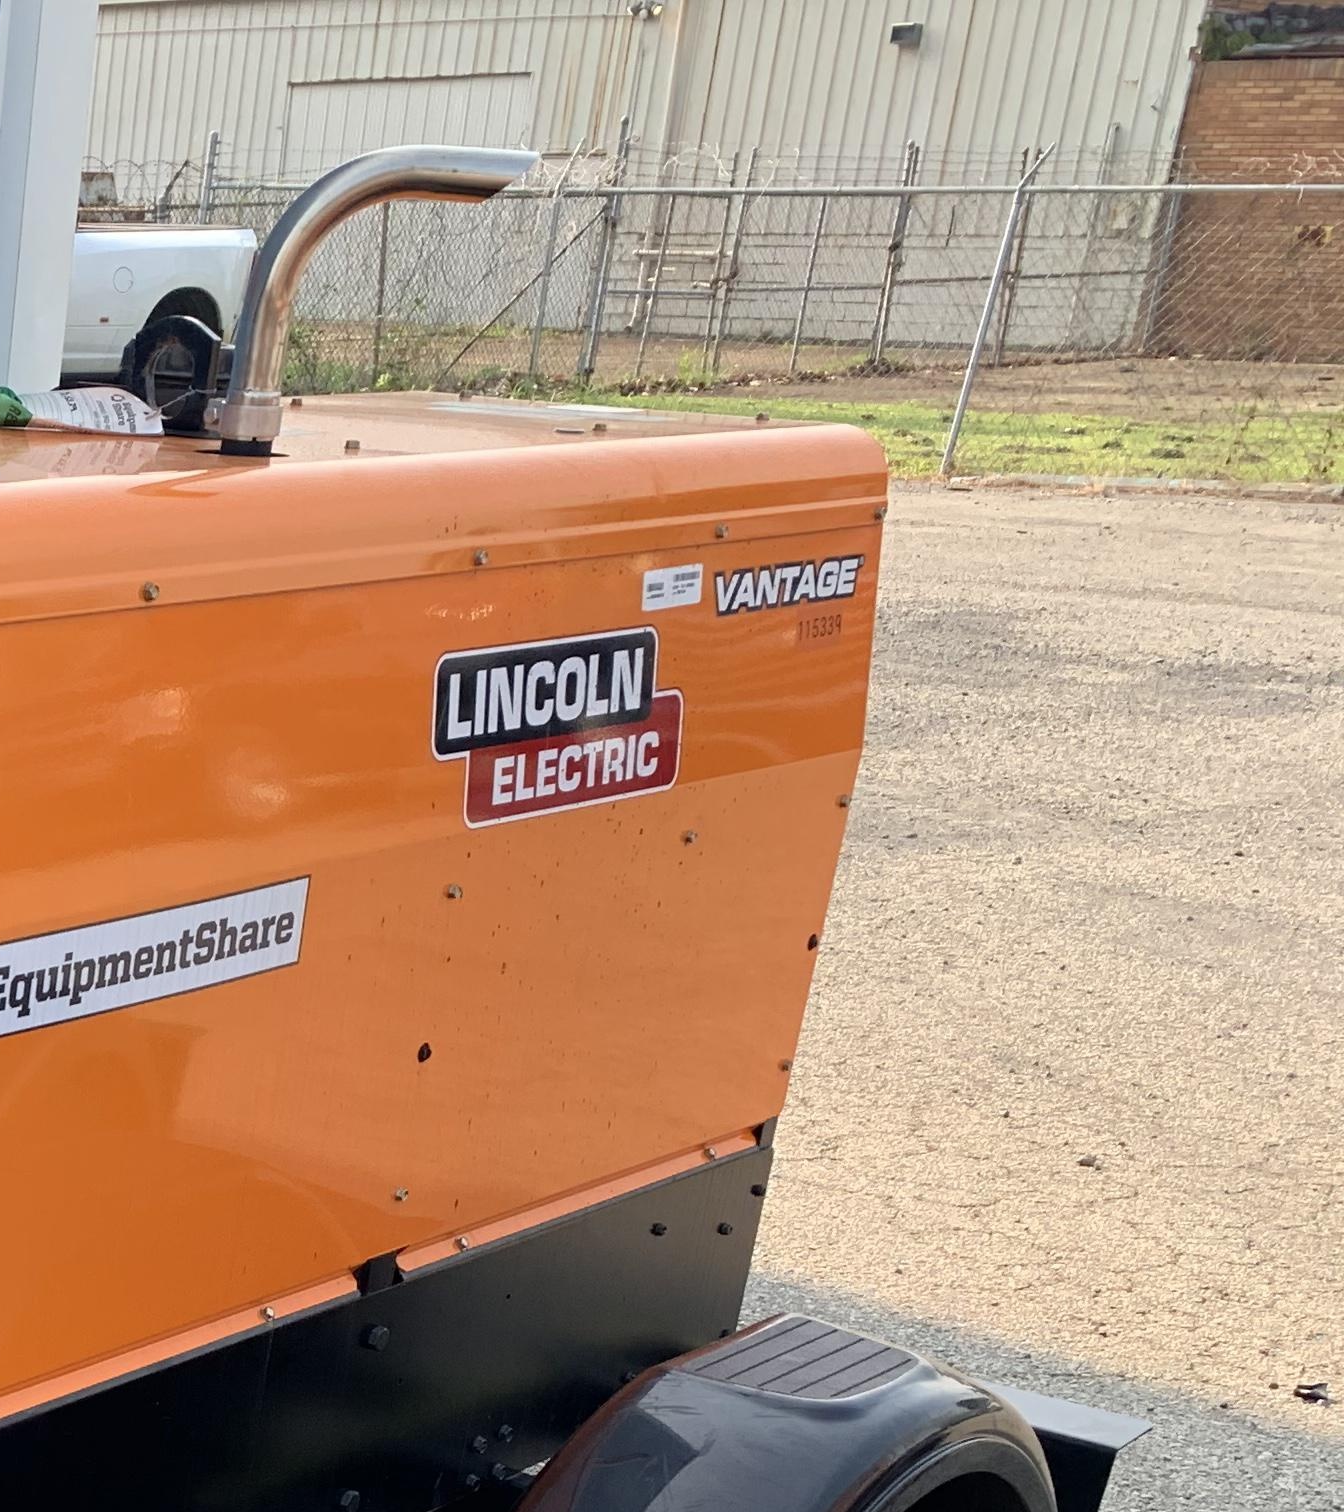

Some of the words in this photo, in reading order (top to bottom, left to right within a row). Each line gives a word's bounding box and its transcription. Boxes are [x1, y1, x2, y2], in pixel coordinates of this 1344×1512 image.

[715, 556, 861, 614] VANTAGE
[799, 614, 842, 641] 115339
[446, 647, 645, 740] LINCOLN
[491, 730, 660, 806] ELECTRIC
